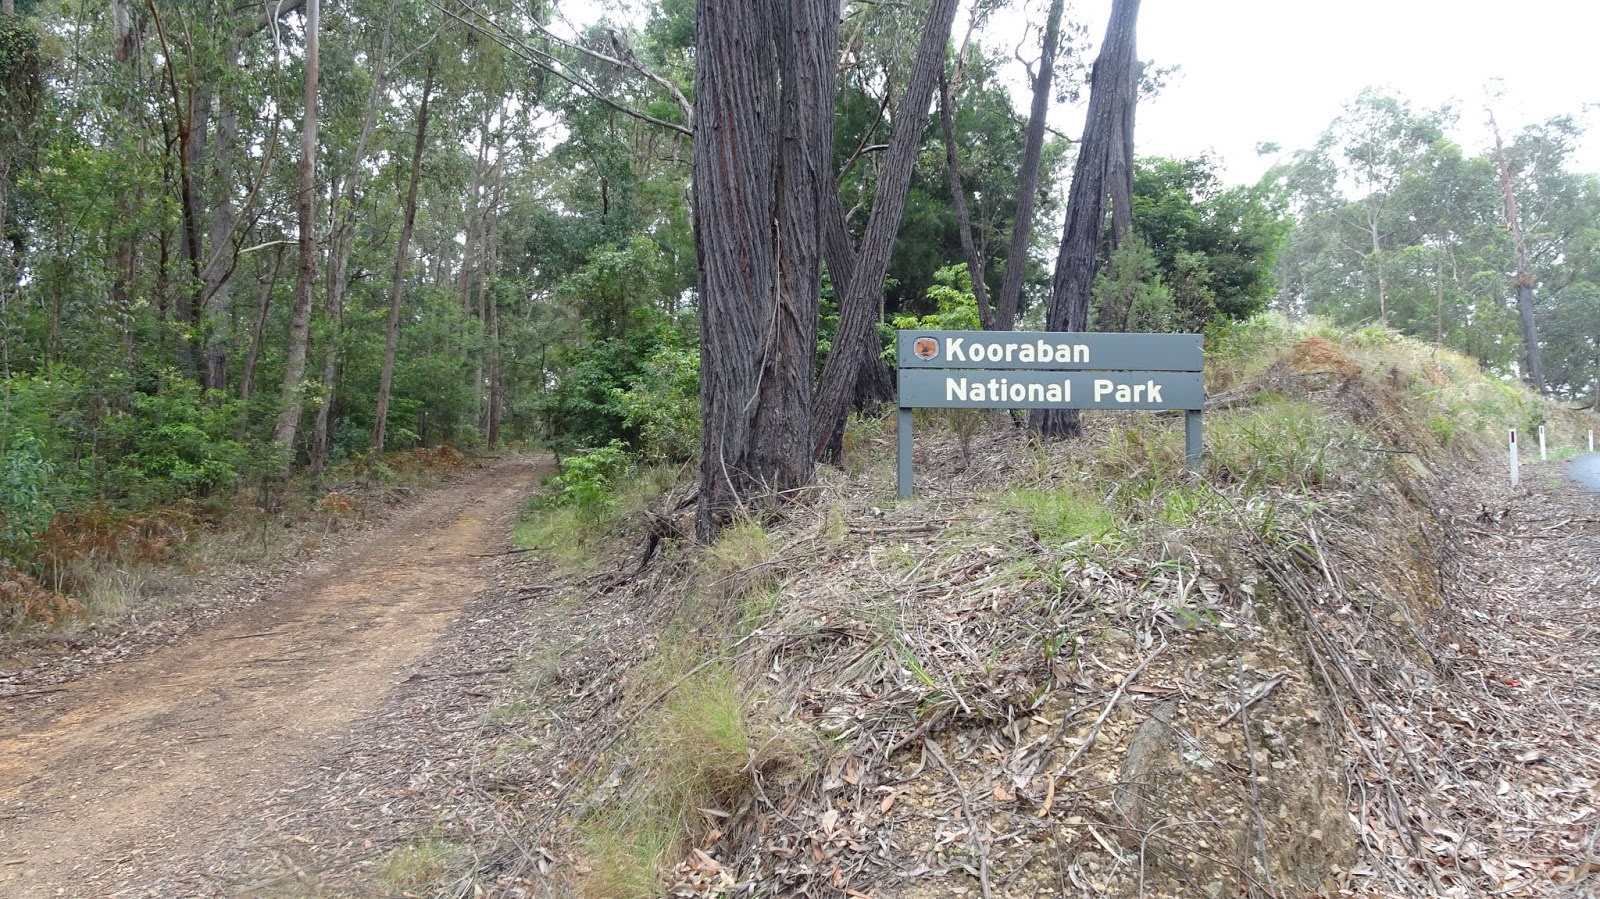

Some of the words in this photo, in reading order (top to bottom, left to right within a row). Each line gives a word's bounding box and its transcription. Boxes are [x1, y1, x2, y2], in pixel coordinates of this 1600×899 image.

[945, 337, 1090, 363] Kooraban
[946, 377, 1071, 403] National
[1093, 379, 1163, 403] Park
